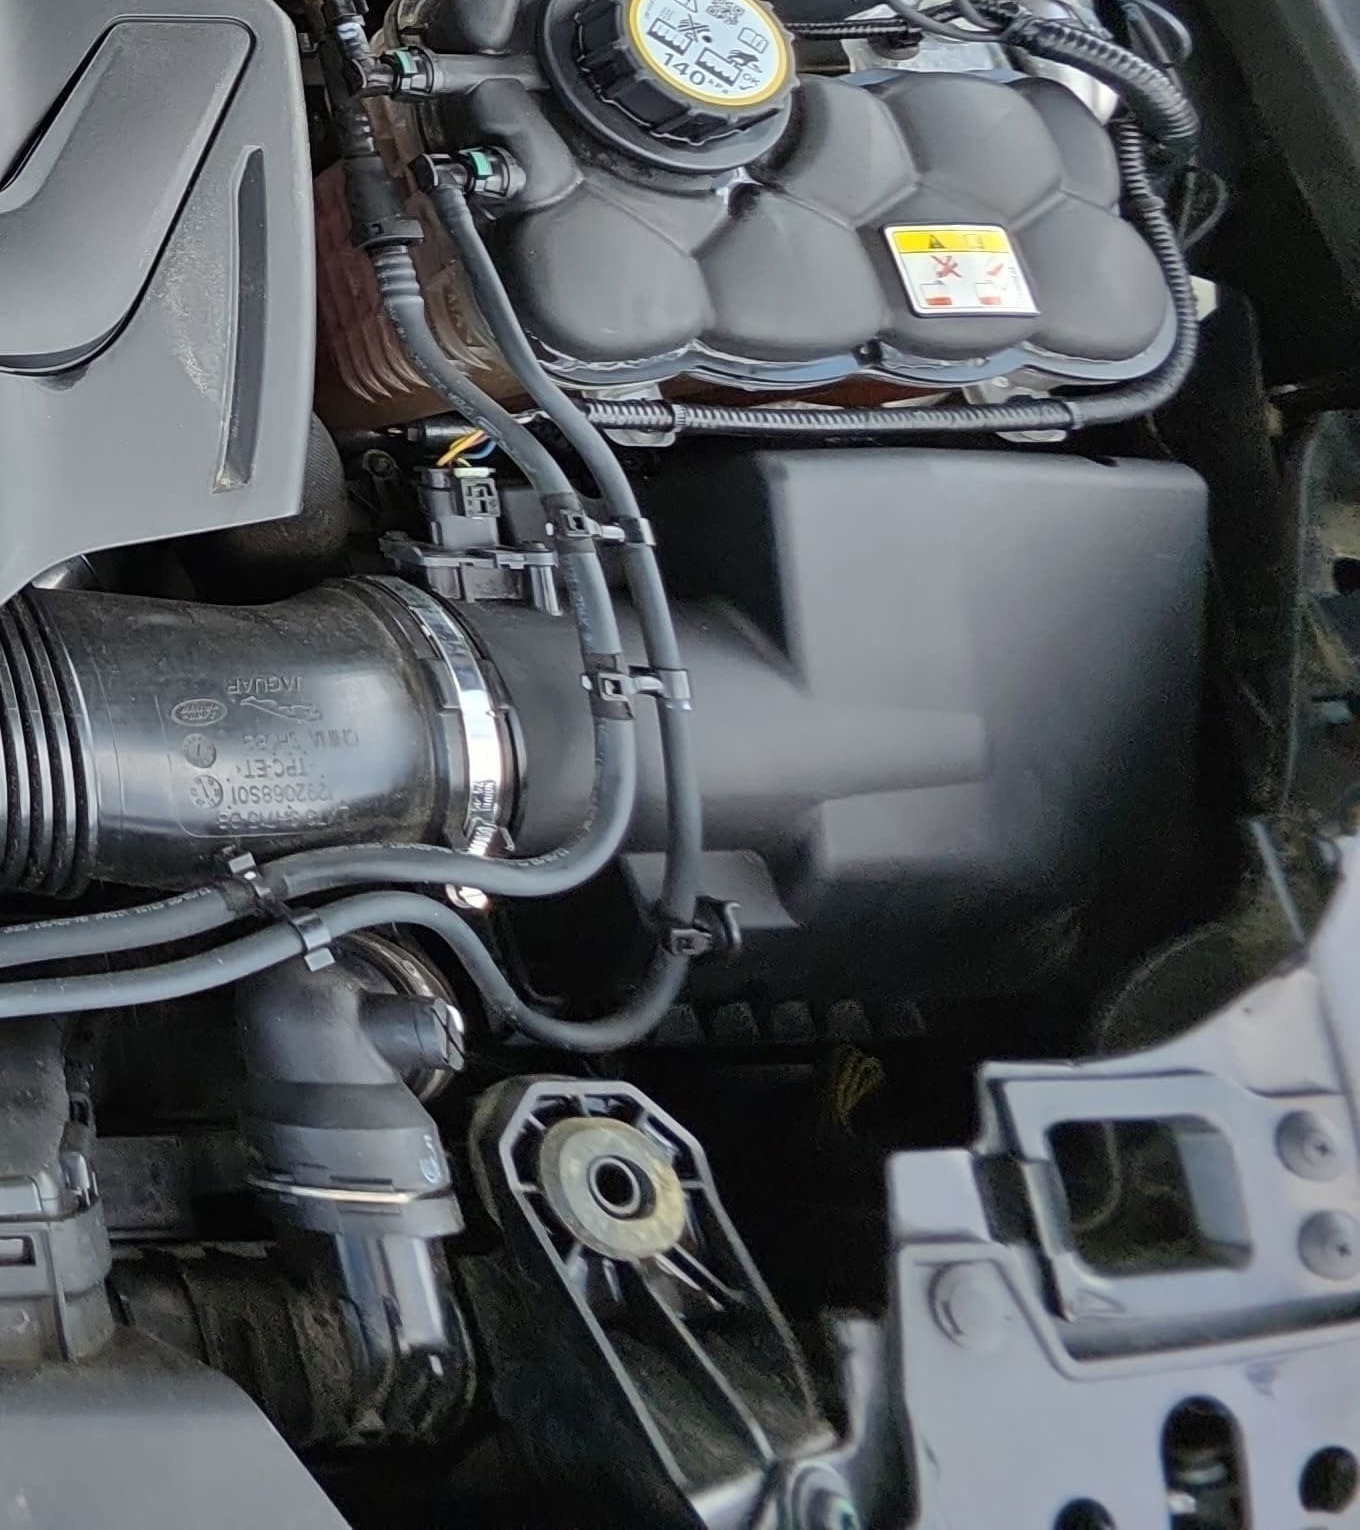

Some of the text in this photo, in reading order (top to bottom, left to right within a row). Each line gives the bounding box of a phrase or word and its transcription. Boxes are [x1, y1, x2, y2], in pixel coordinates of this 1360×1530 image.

[663, 52, 706, 86] 140
[742, 73, 761, 87] OK
[225, 675, 303, 695] JAGUAR
